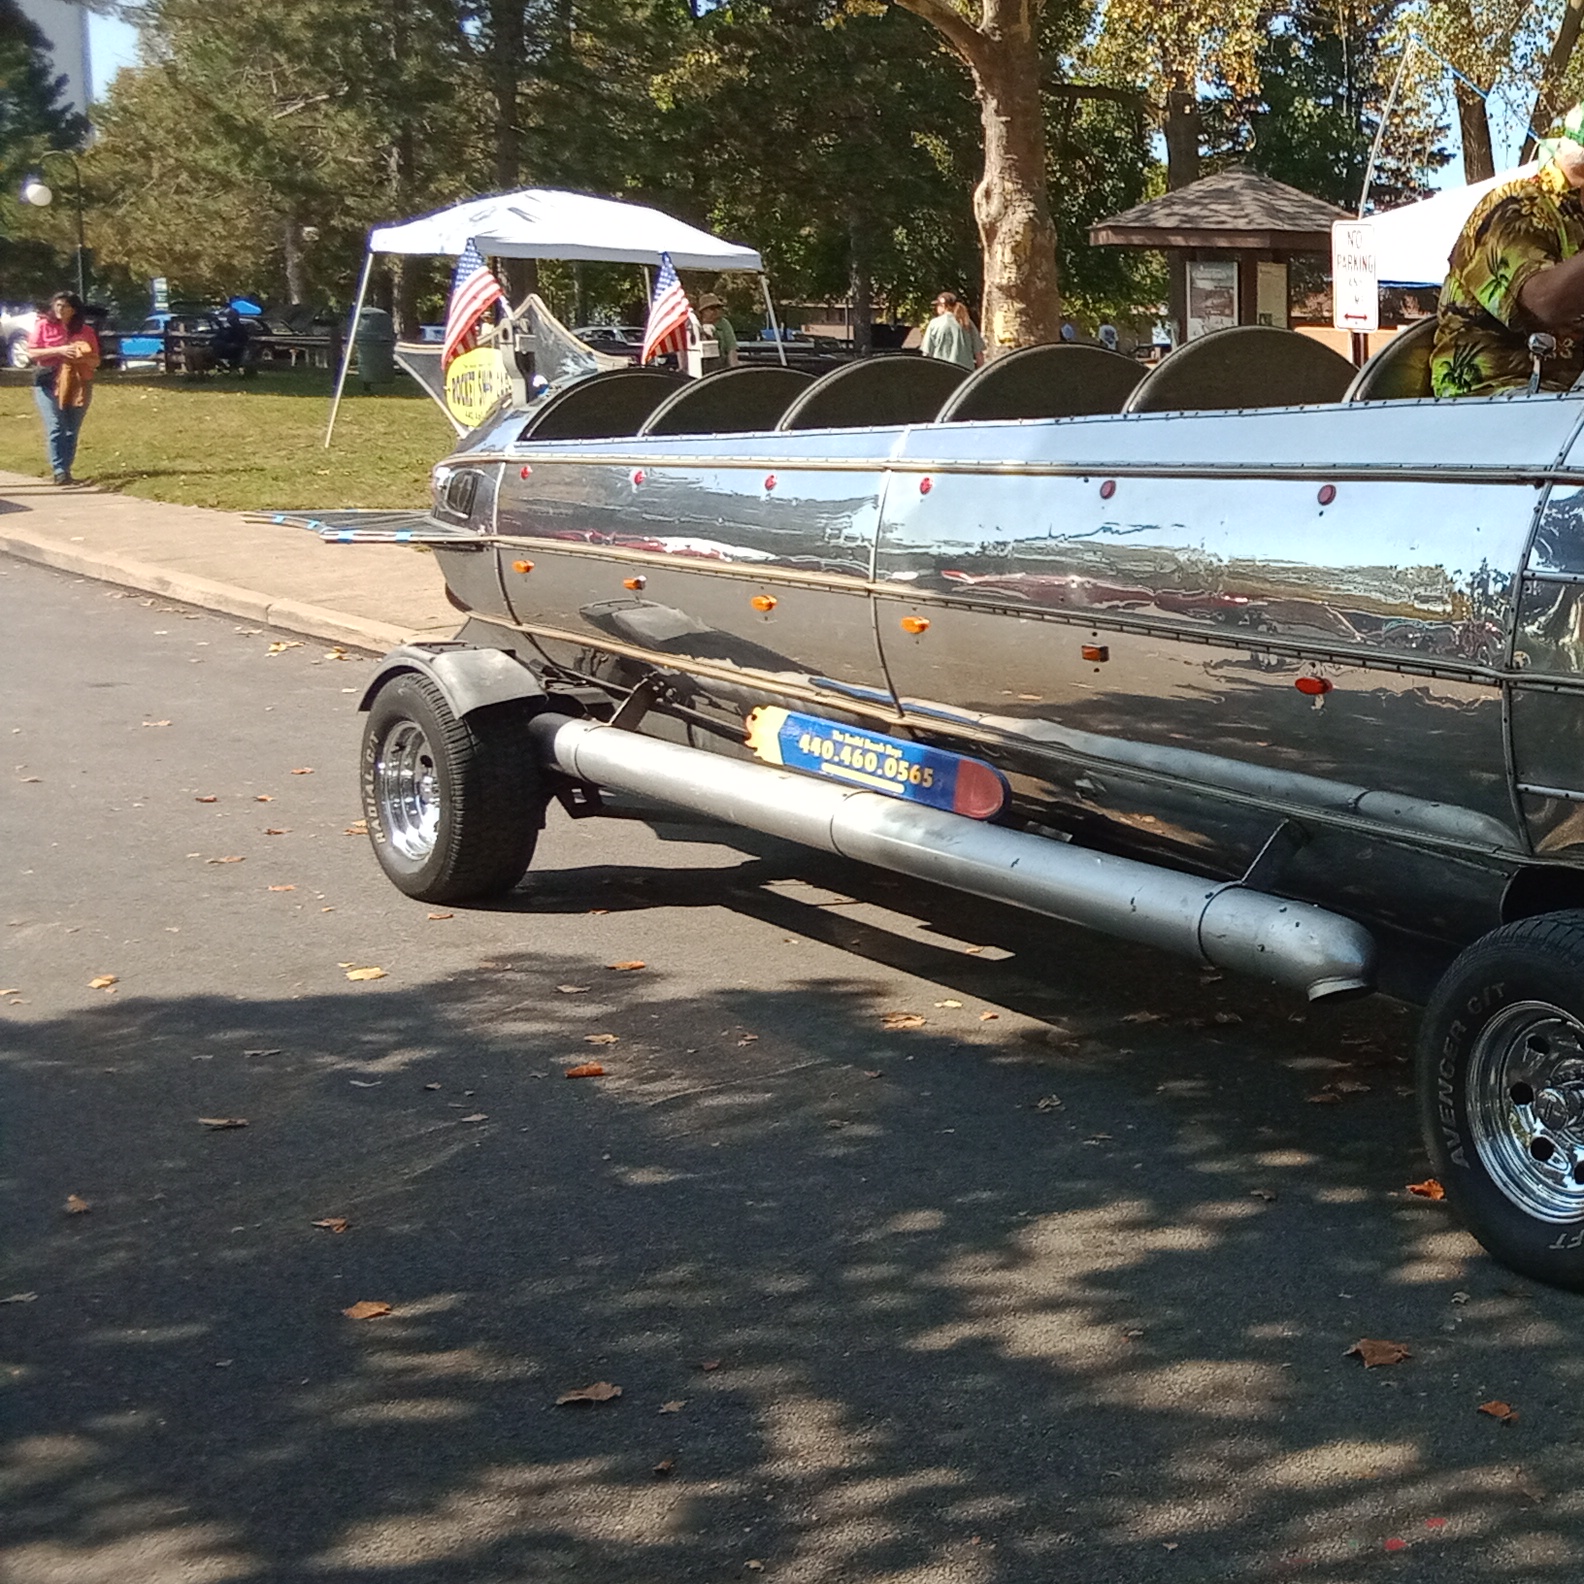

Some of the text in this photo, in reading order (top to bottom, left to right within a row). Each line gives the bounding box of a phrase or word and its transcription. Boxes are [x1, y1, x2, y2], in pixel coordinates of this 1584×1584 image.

[1336, 253, 1373, 273] PARKING
[1347, 229, 1362, 249] NO
[799, 734, 934, 787] 440.460.0565
[365, 770, 385, 843] RADIAL
[1437, 982, 1507, 1169] AVENGER G/T
